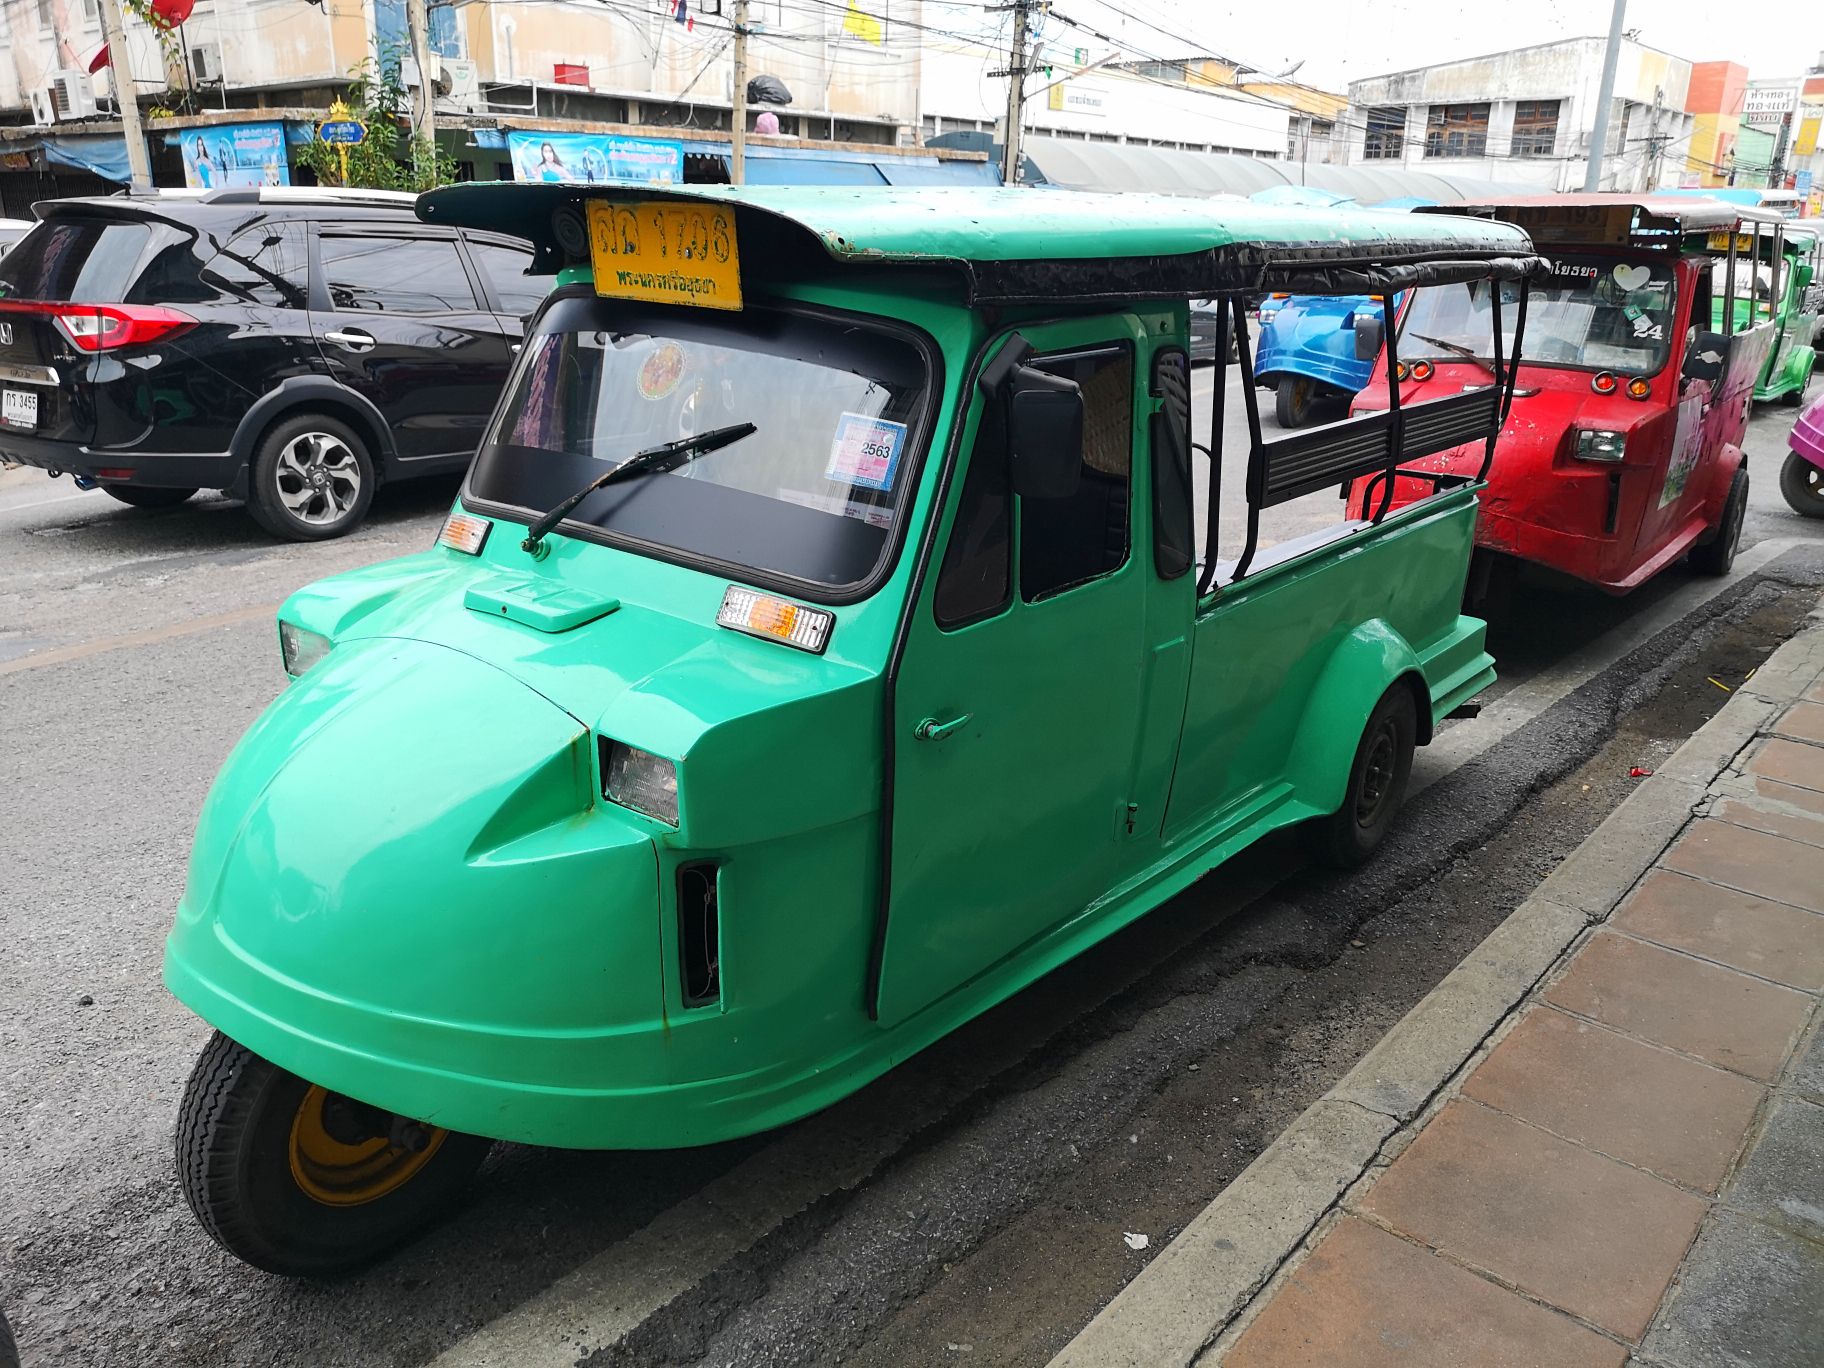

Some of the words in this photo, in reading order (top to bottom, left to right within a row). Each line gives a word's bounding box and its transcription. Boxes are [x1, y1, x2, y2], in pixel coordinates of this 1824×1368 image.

[653, 207, 730, 264] 1706
[1549, 260, 1598, 279] โยธยา
[616, 269, 717, 298] พระนครศรีอยุธยา
[1633, 323, 1664, 340] 24
[19, 394, 37, 410] 3455
[861, 441, 891, 459] 2563
